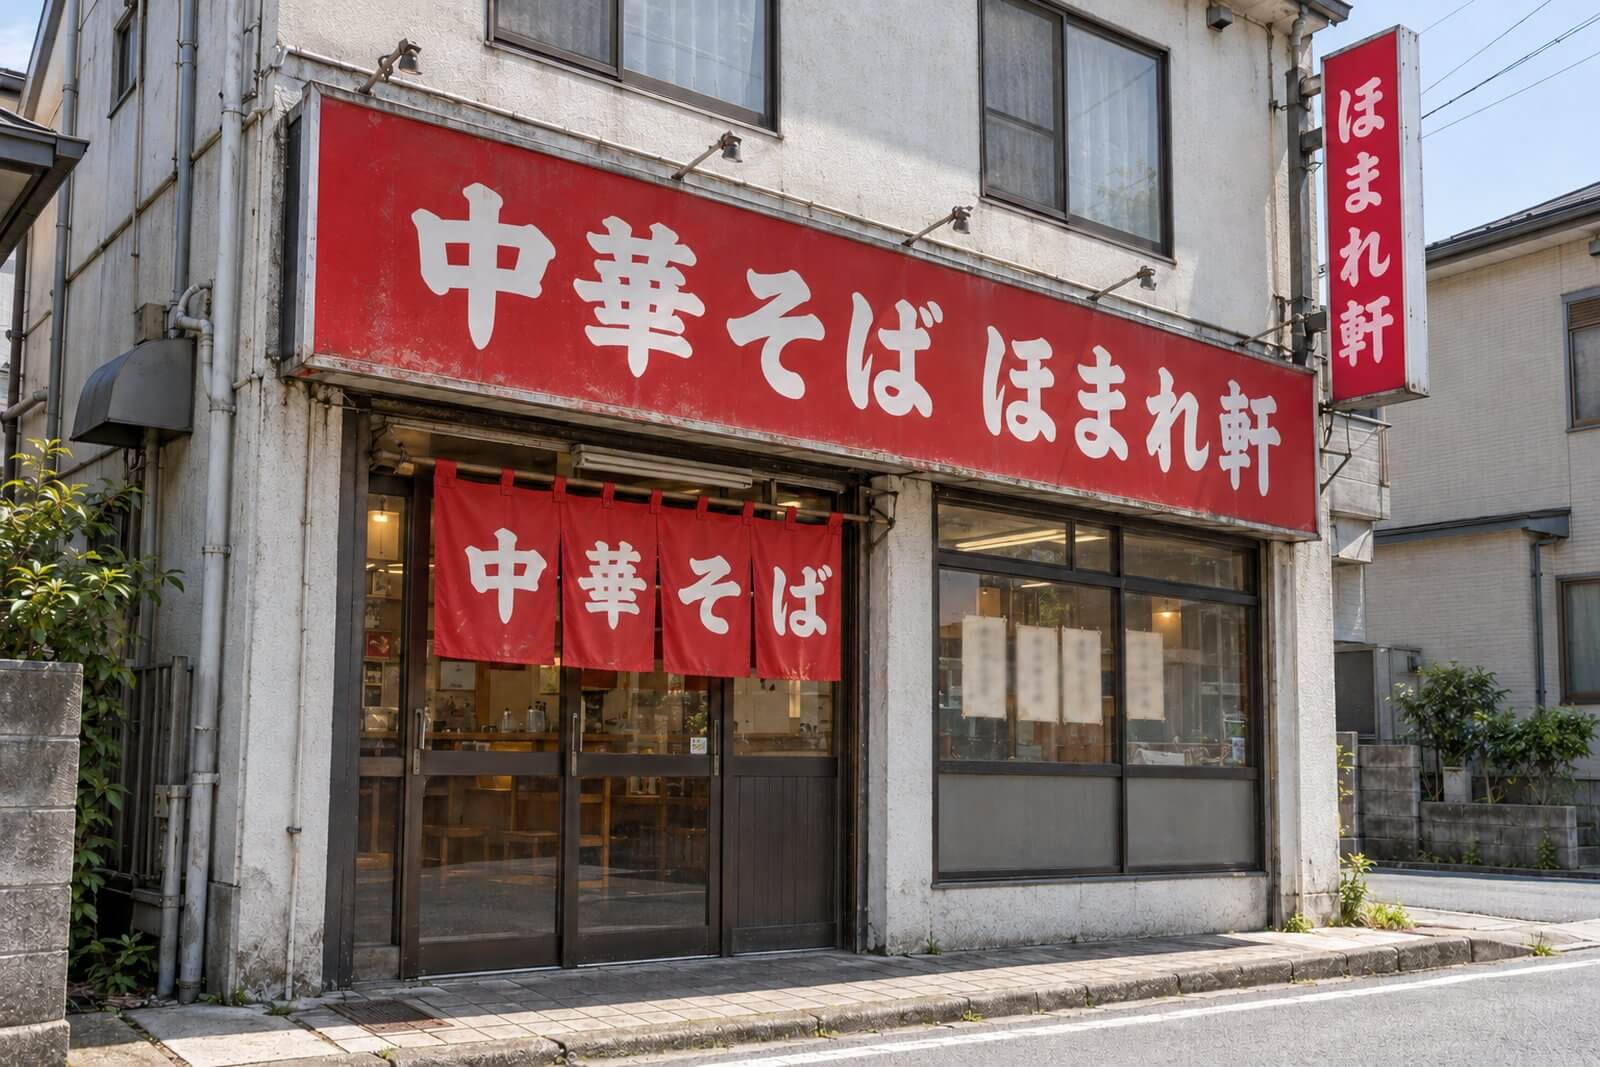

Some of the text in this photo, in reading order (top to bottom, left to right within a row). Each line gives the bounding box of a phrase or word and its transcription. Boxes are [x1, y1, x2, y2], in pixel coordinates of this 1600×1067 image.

[411, 182, 1281, 497] 中華そば ほまれ軒
[1338, 76, 1394, 367] ほまれ軒
[464, 527, 833, 638] 中華そば
